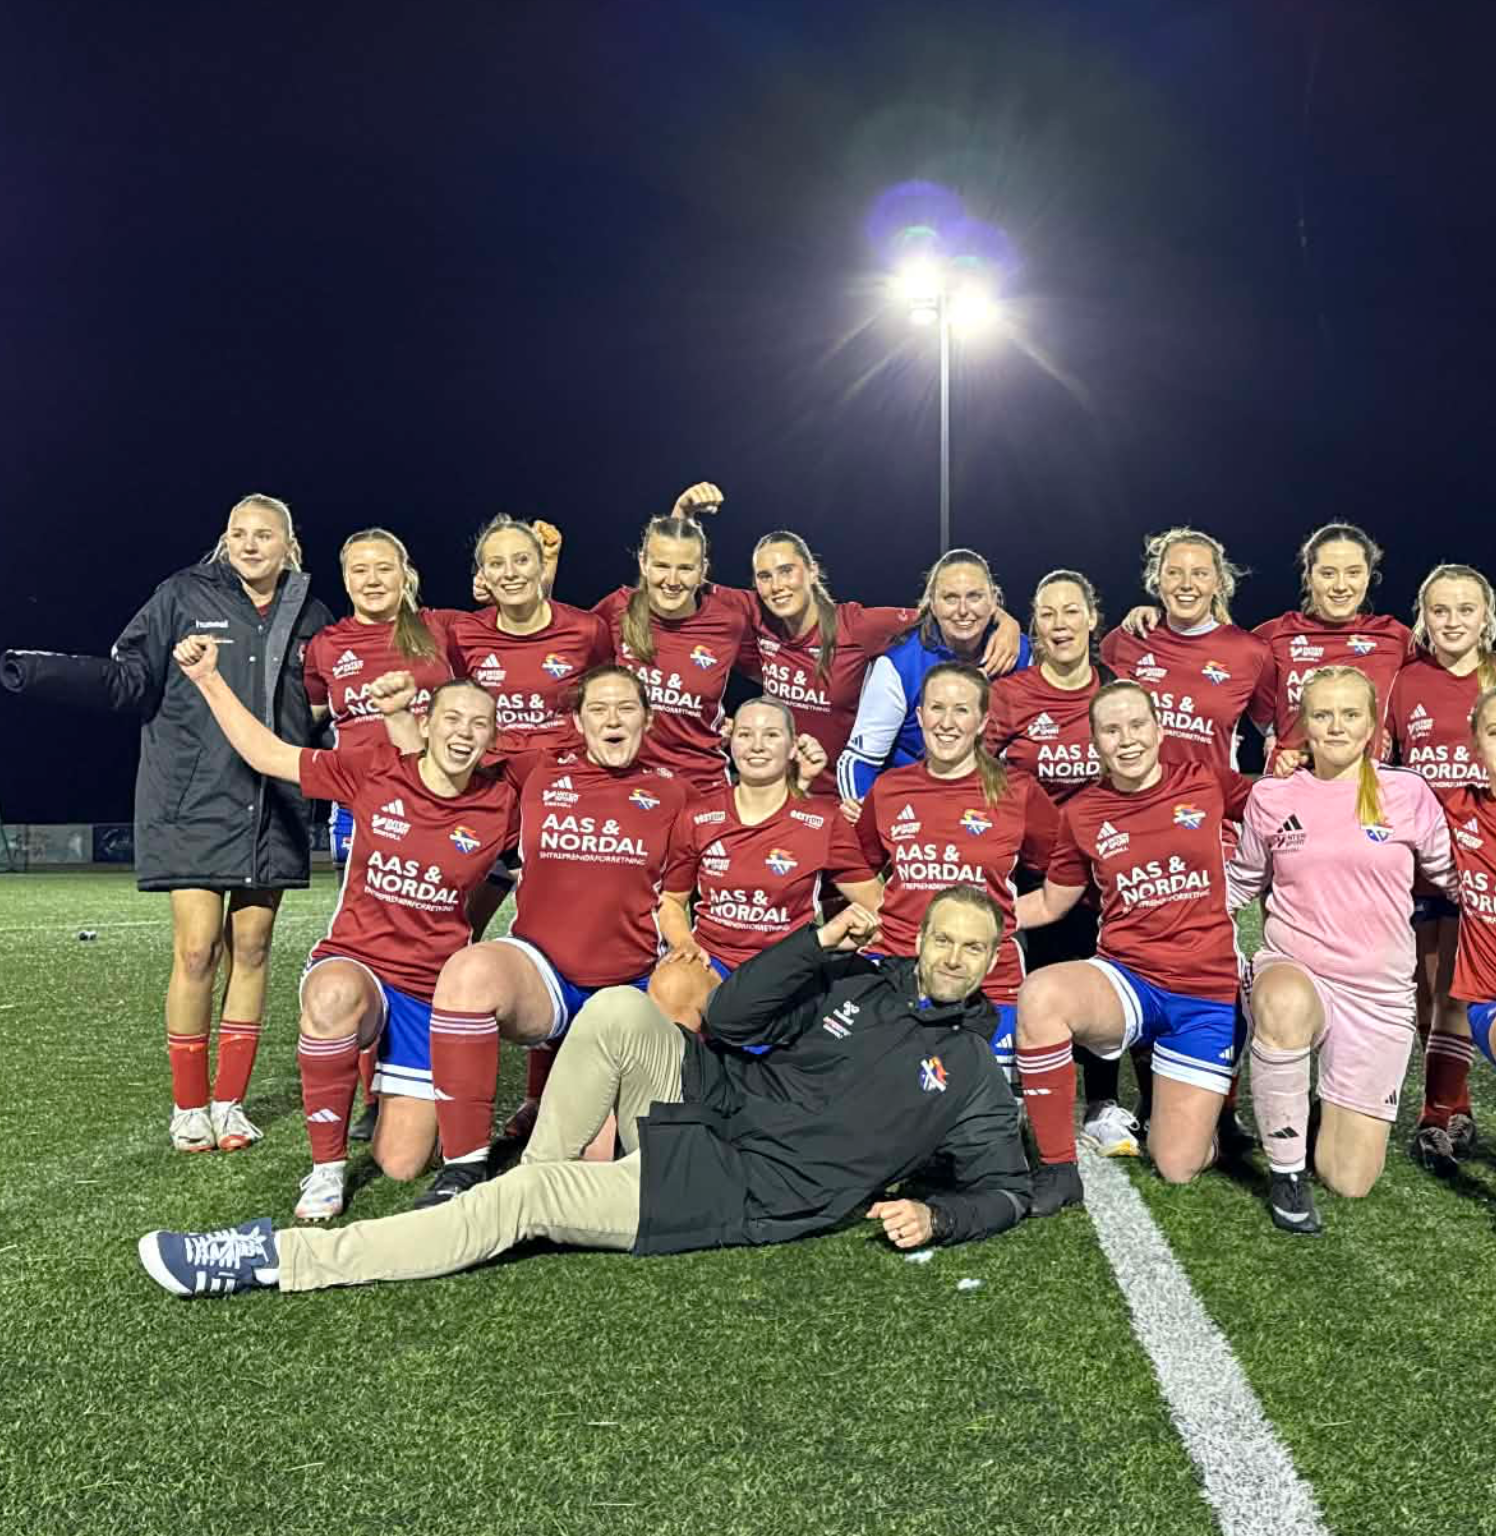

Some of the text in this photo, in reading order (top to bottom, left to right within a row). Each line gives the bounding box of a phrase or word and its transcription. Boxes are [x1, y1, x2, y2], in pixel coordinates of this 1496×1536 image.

[634, 666, 683, 689] AS &
[793, 670, 807, 685] &
[1286, 669, 1315, 686] AA
[344, 683, 371, 703] AA
[497, 693, 544, 709] AS &
[645, 685, 703, 709] RDAL
[763, 676, 831, 705] ORDAL
[1179, 696, 1194, 713] &
[1155, 709, 1215, 736] RDAL
[1038, 744, 1082, 761] AAS
[1409, 745, 1471, 763] AAS &
[1038, 761, 1100, 777] NORD
[541, 813, 620, 836] AAS &
[540, 831, 649, 857] NORDAL
[895, 843, 960, 862] AAS &
[367, 850, 443, 885] AAS &
[896, 862, 987, 883] NORDAL
[1116, 855, 1186, 892] AAS &
[366, 868, 459, 905] NORDAL
[1121, 870, 1211, 907] NORDAL
[1462, 869, 1488, 891] AS
[749, 889, 769, 906] &
[710, 901, 792, 924] NORDAL
